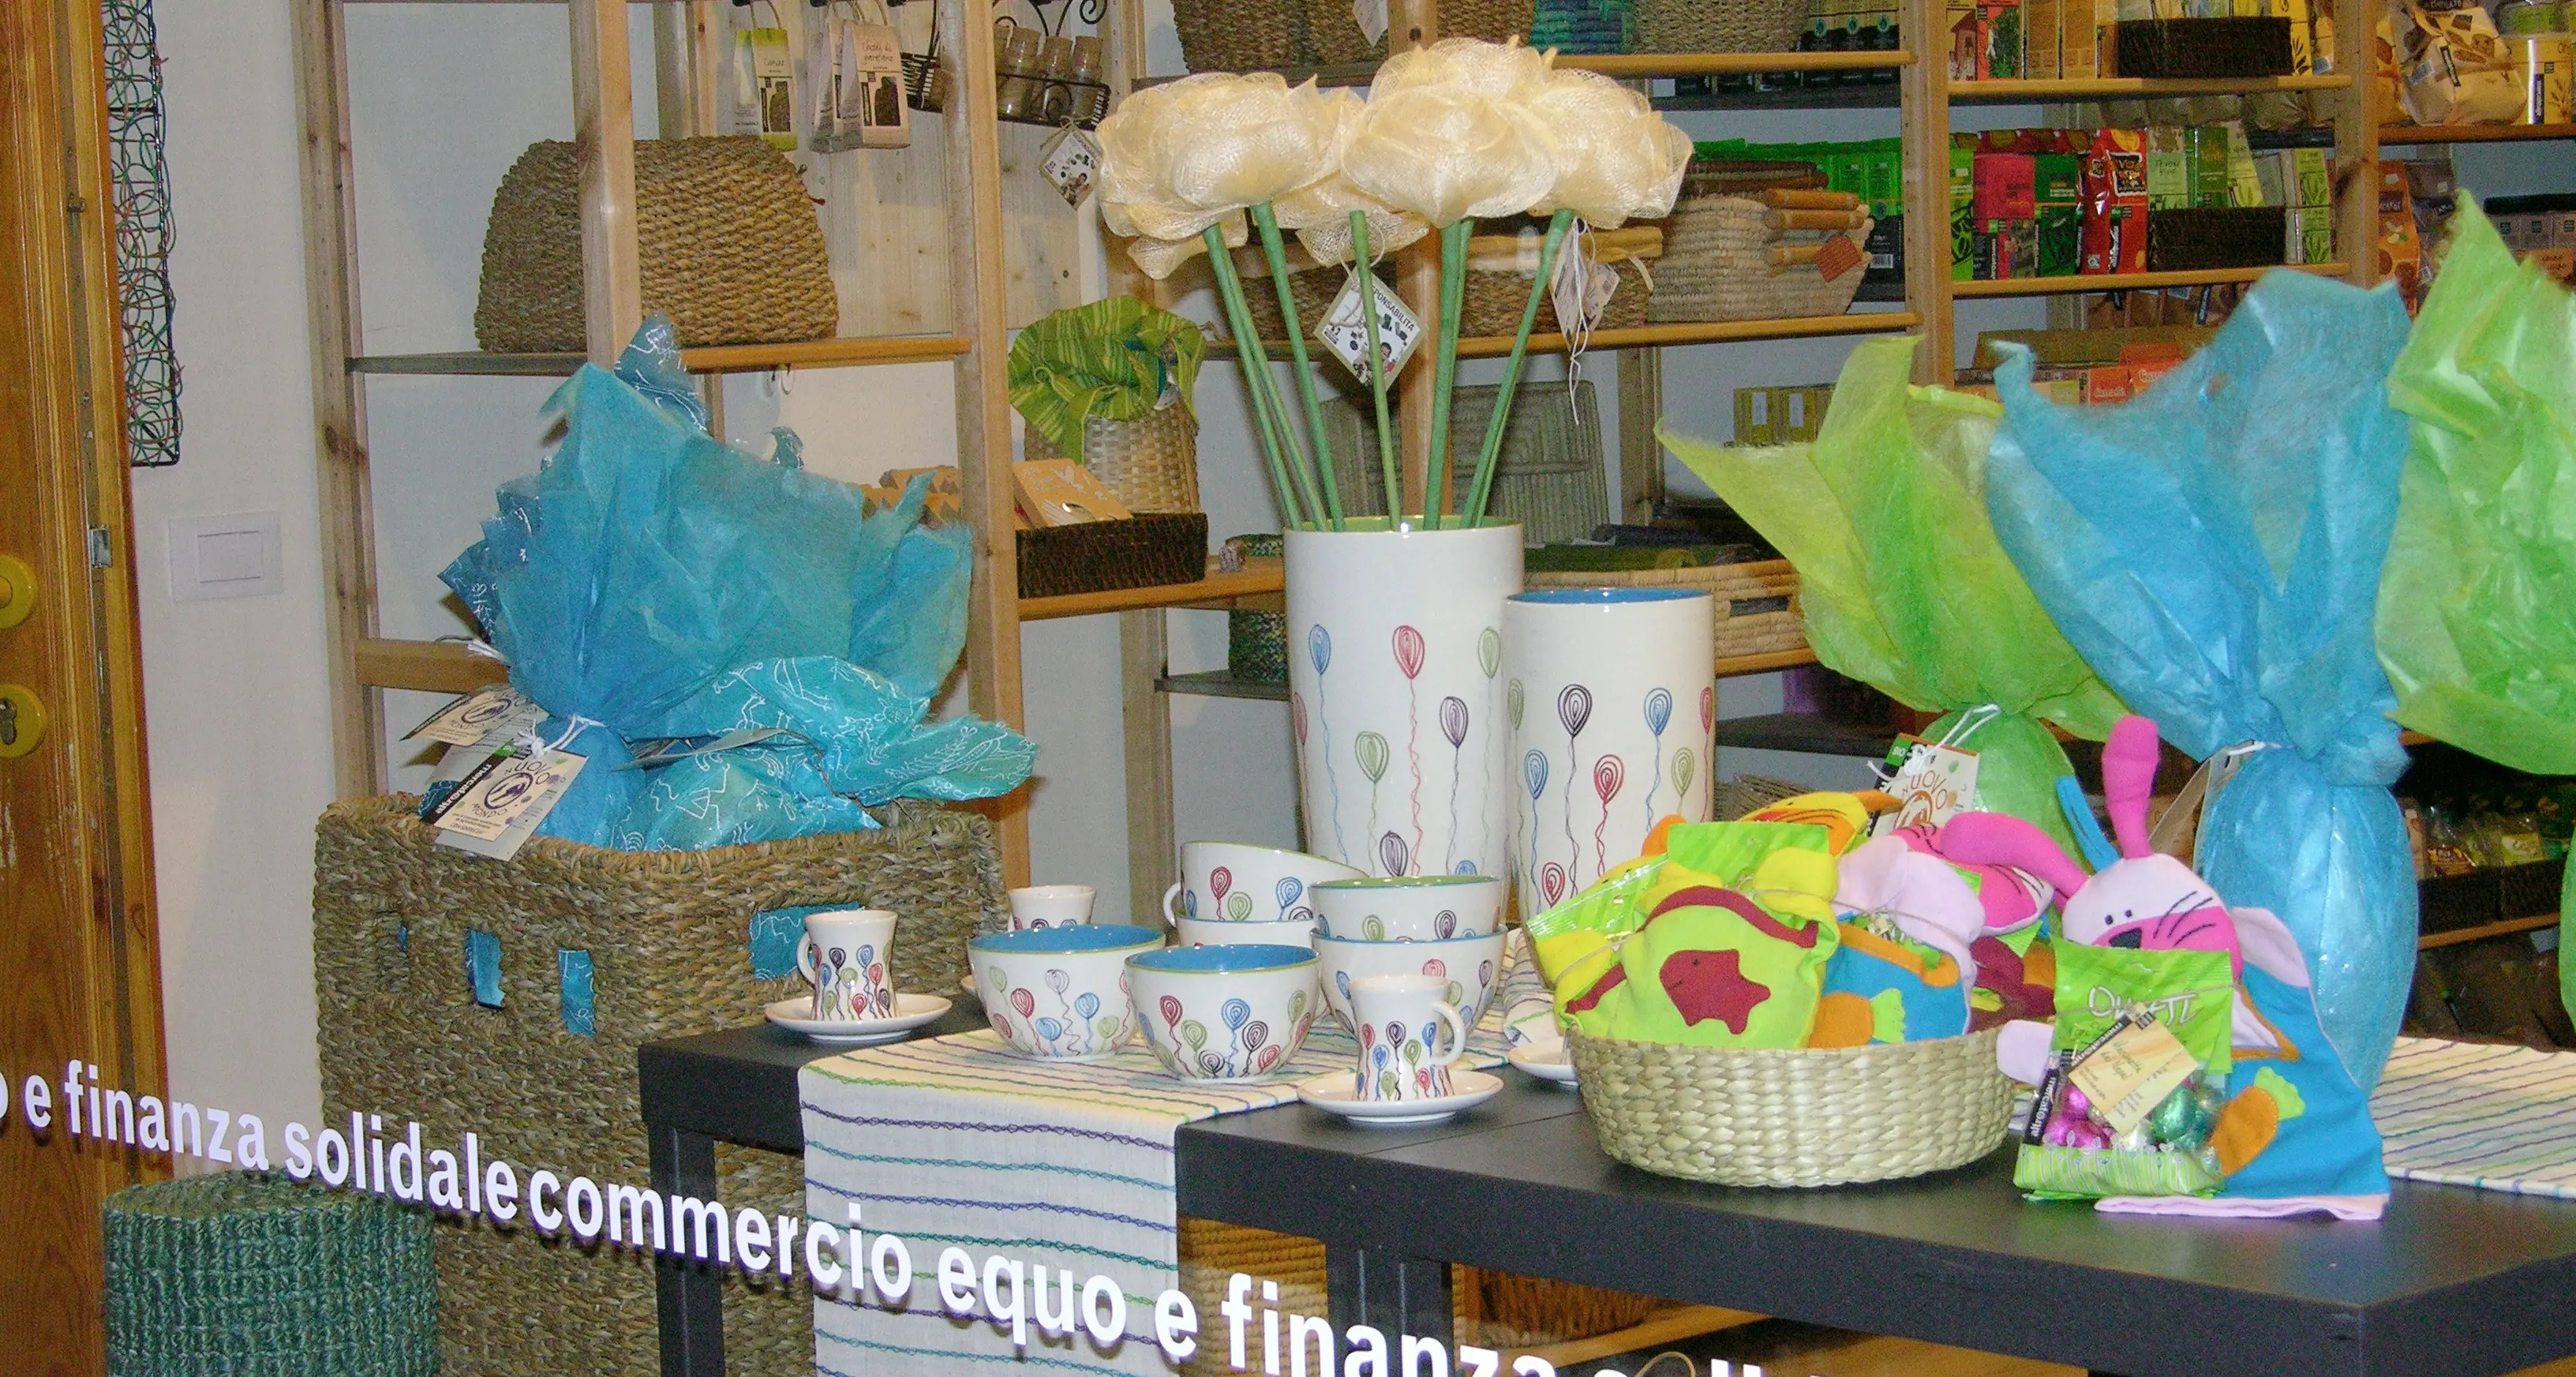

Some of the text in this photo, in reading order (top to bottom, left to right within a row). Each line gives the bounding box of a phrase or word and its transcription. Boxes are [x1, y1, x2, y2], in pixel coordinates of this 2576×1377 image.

[25, 1074, 52, 1128] e
[65, 1059, 270, 1172] finanza
[285, 1111, 519, 1220] solidale
[530, 1170, 913, 1299] commercio
[938, 1246, 1128, 1345] equo
[1154, 1287, 1198, 1357] e
[1221, 1273, 1556, 1377] finan
